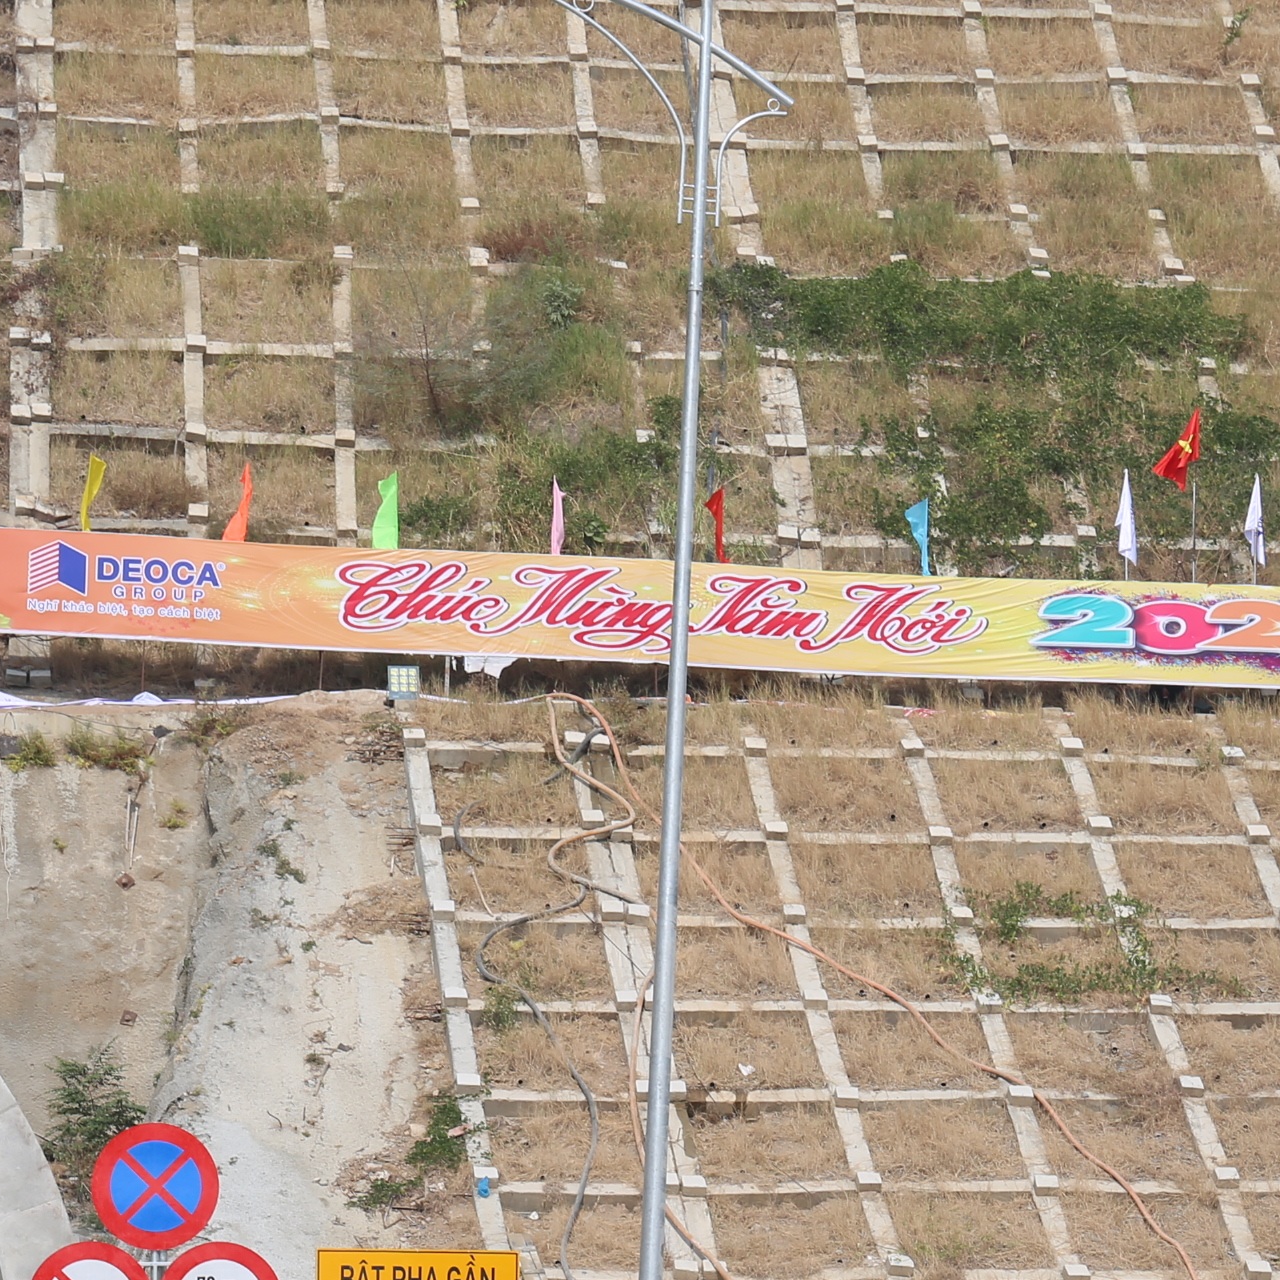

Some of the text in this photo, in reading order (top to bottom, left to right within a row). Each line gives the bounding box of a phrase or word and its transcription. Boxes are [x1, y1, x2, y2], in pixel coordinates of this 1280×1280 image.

[96, 557, 220, 588] DEOCA
[113, 586, 205, 602] GROUP
[336, 561, 506, 633] Chúc
[470, 566, 674, 653] Mừng
[688, 575, 828, 638] Năm
[797, 583, 987, 653] Mới
[28, 600, 221, 621] Nghĩ khác biệt, tạo cách biệt
